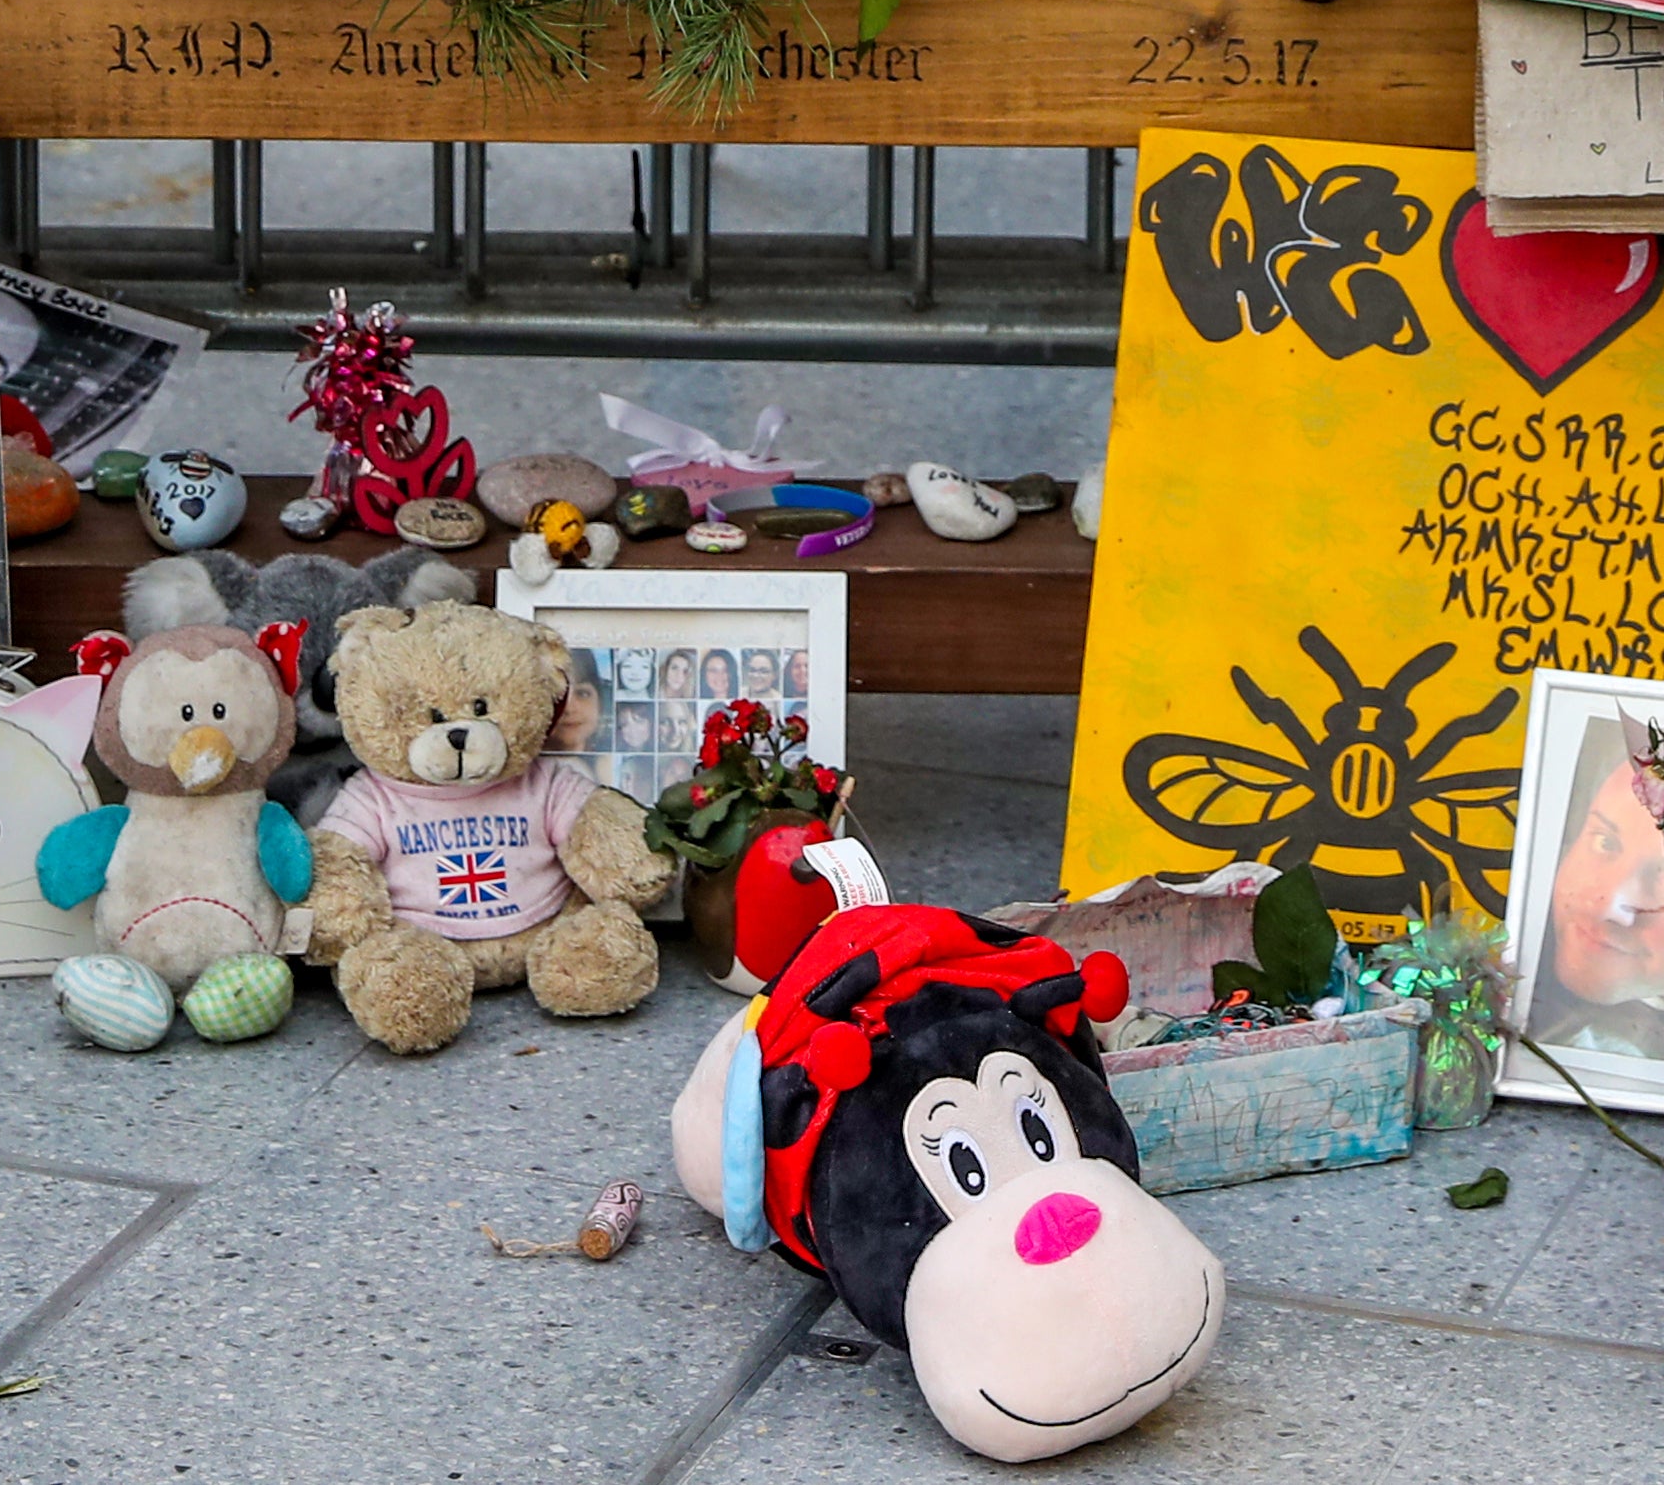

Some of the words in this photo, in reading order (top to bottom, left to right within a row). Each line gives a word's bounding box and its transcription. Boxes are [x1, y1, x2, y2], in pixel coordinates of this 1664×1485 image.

[108, 21, 281, 78] R.I.P.
[165, 480, 217, 501] 2017
[396, 815, 530, 856] MANCHESTER
[830, 866, 851, 909] WARNING
